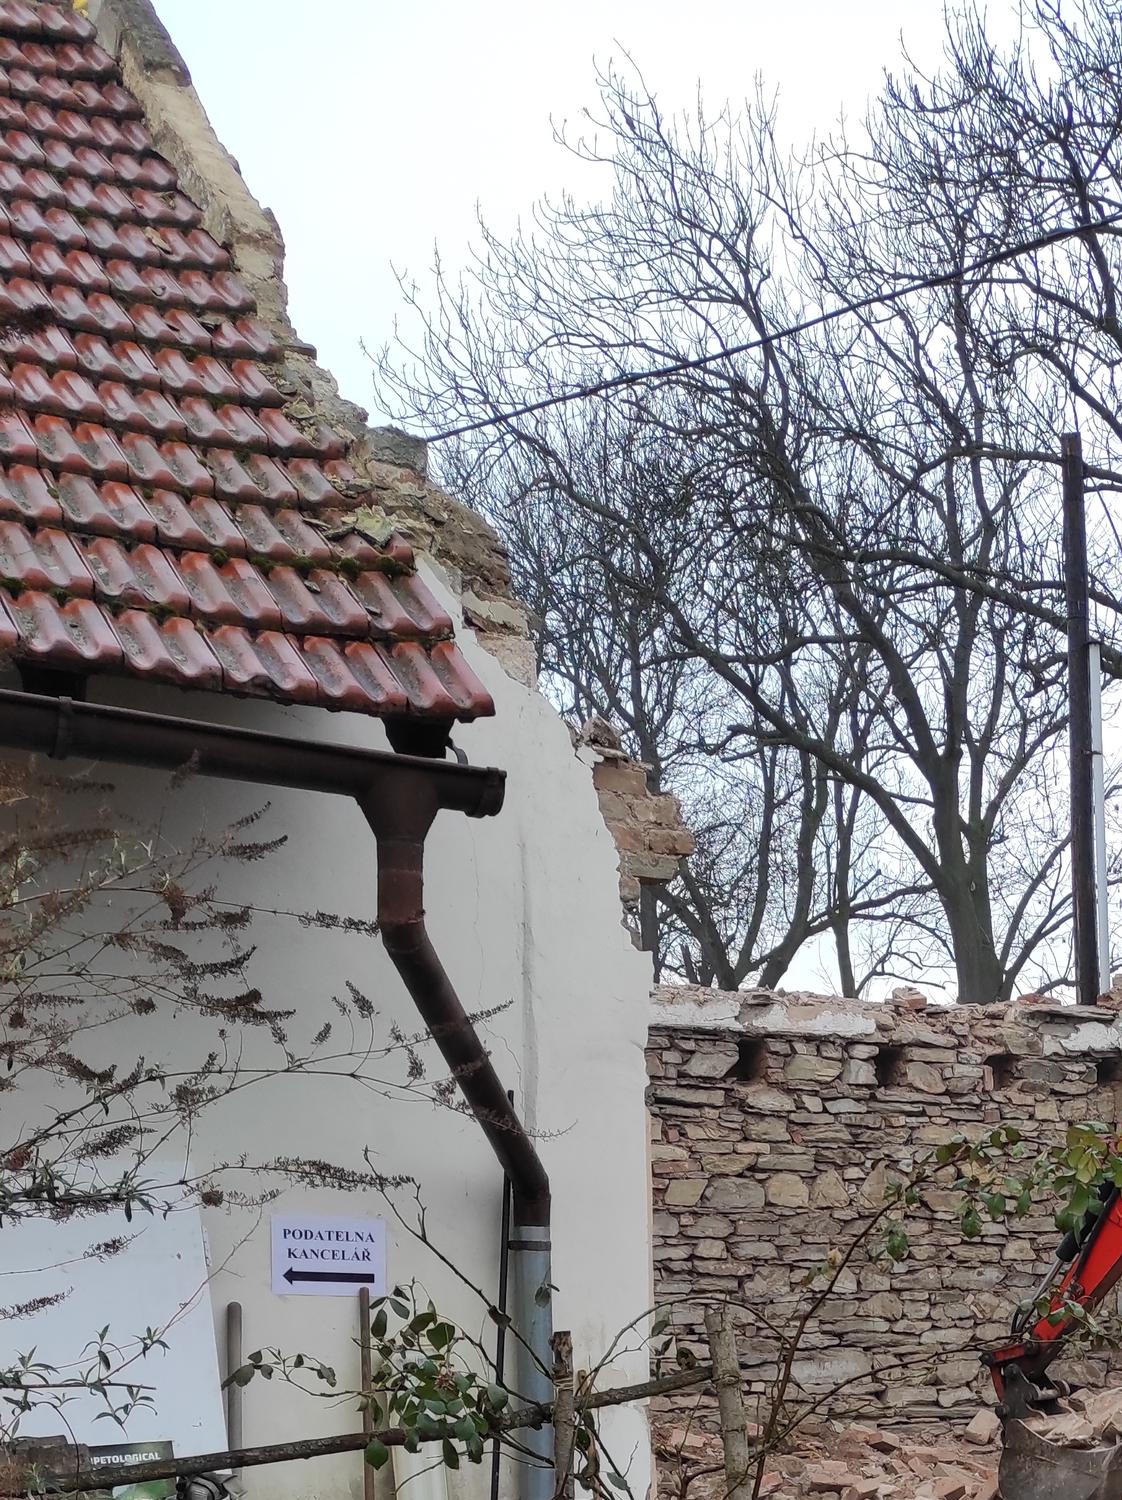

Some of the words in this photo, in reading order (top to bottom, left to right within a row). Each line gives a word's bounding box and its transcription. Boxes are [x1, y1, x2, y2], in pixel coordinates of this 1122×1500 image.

[283, 1228, 375, 1243] PODATELNA
[286, 1247, 371, 1262] KANCELÁŘ
[91, 1452, 161, 1465] PETOLOGICAL
